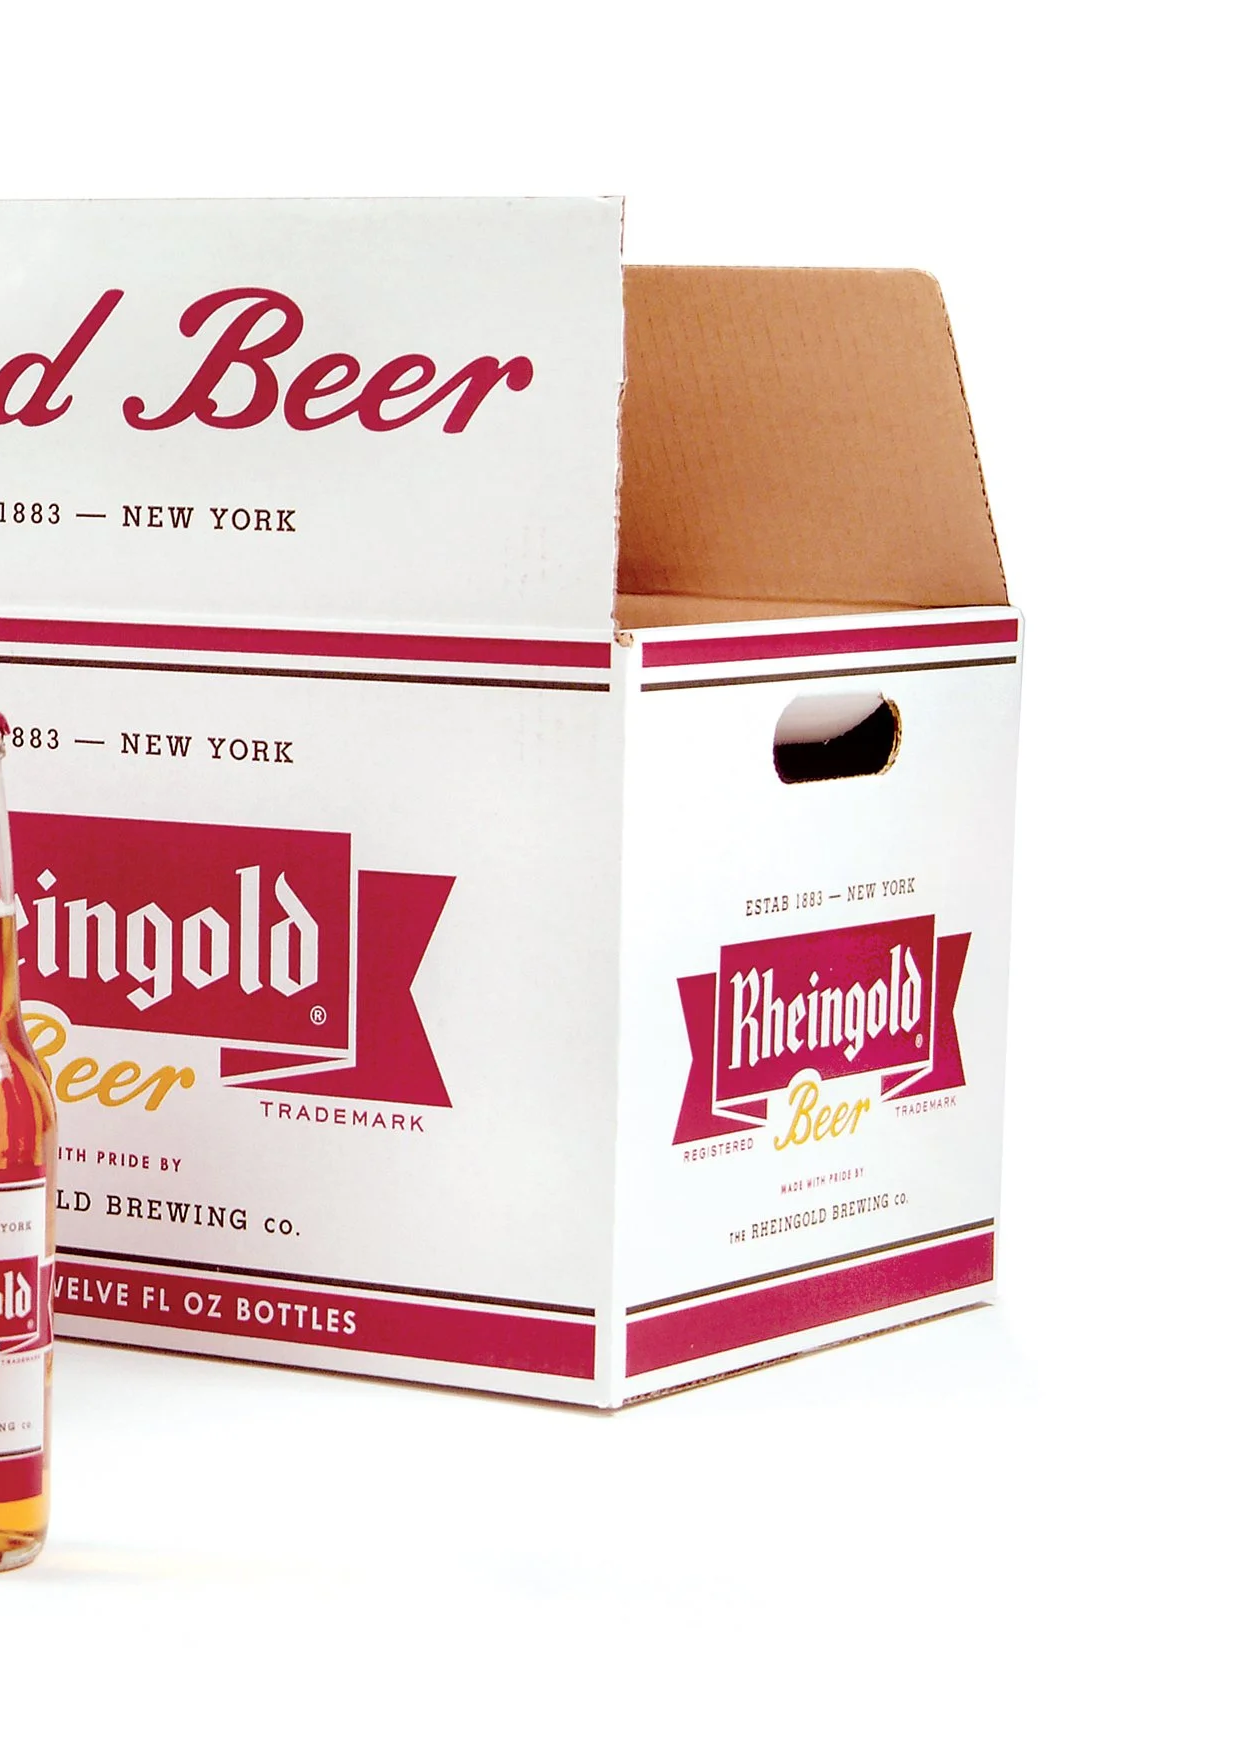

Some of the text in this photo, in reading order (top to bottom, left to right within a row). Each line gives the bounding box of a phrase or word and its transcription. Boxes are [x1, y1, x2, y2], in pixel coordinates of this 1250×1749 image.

[123, 287, 534, 434] Beer
[0, 501, 60, 525] 1883
[122, 505, 195, 529] NEW
[209, 507, 296, 533] YORK
[12, 726, 59, 750] 883
[120, 732, 193, 758] NEW
[207, 737, 294, 764] YORK
[745, 895, 789, 917] ESTAB
[796, 890, 823, 910] 1883
[847, 882, 877, 902] NEW
[881, 877, 916, 897] YORK
[728, 944, 922, 1069] Rheingold
[260, 1100, 425, 1134] TRADEMARK
[773, 1080, 870, 1151] Beer
[895, 1096, 956, 1118] TRADEMARK
[58, 1146, 182, 1173] ITH PRIDE BY
[683, 1137, 754, 1163] REGISTERED
[781, 1167, 864, 1194] MADE WITH PRIDE BY
[0, 1221, 32, 1234] YORK
[106, 1194, 247, 1231] BREWING
[729, 1229, 746, 1244] THE
[751, 1207, 827, 1240] RHEINGOLD
[832, 1193, 889, 1221] BREWING
[142, 1286, 170, 1312] FL
[183, 1291, 222, 1319] OZ
[236, 1297, 357, 1334] BOTTLES
